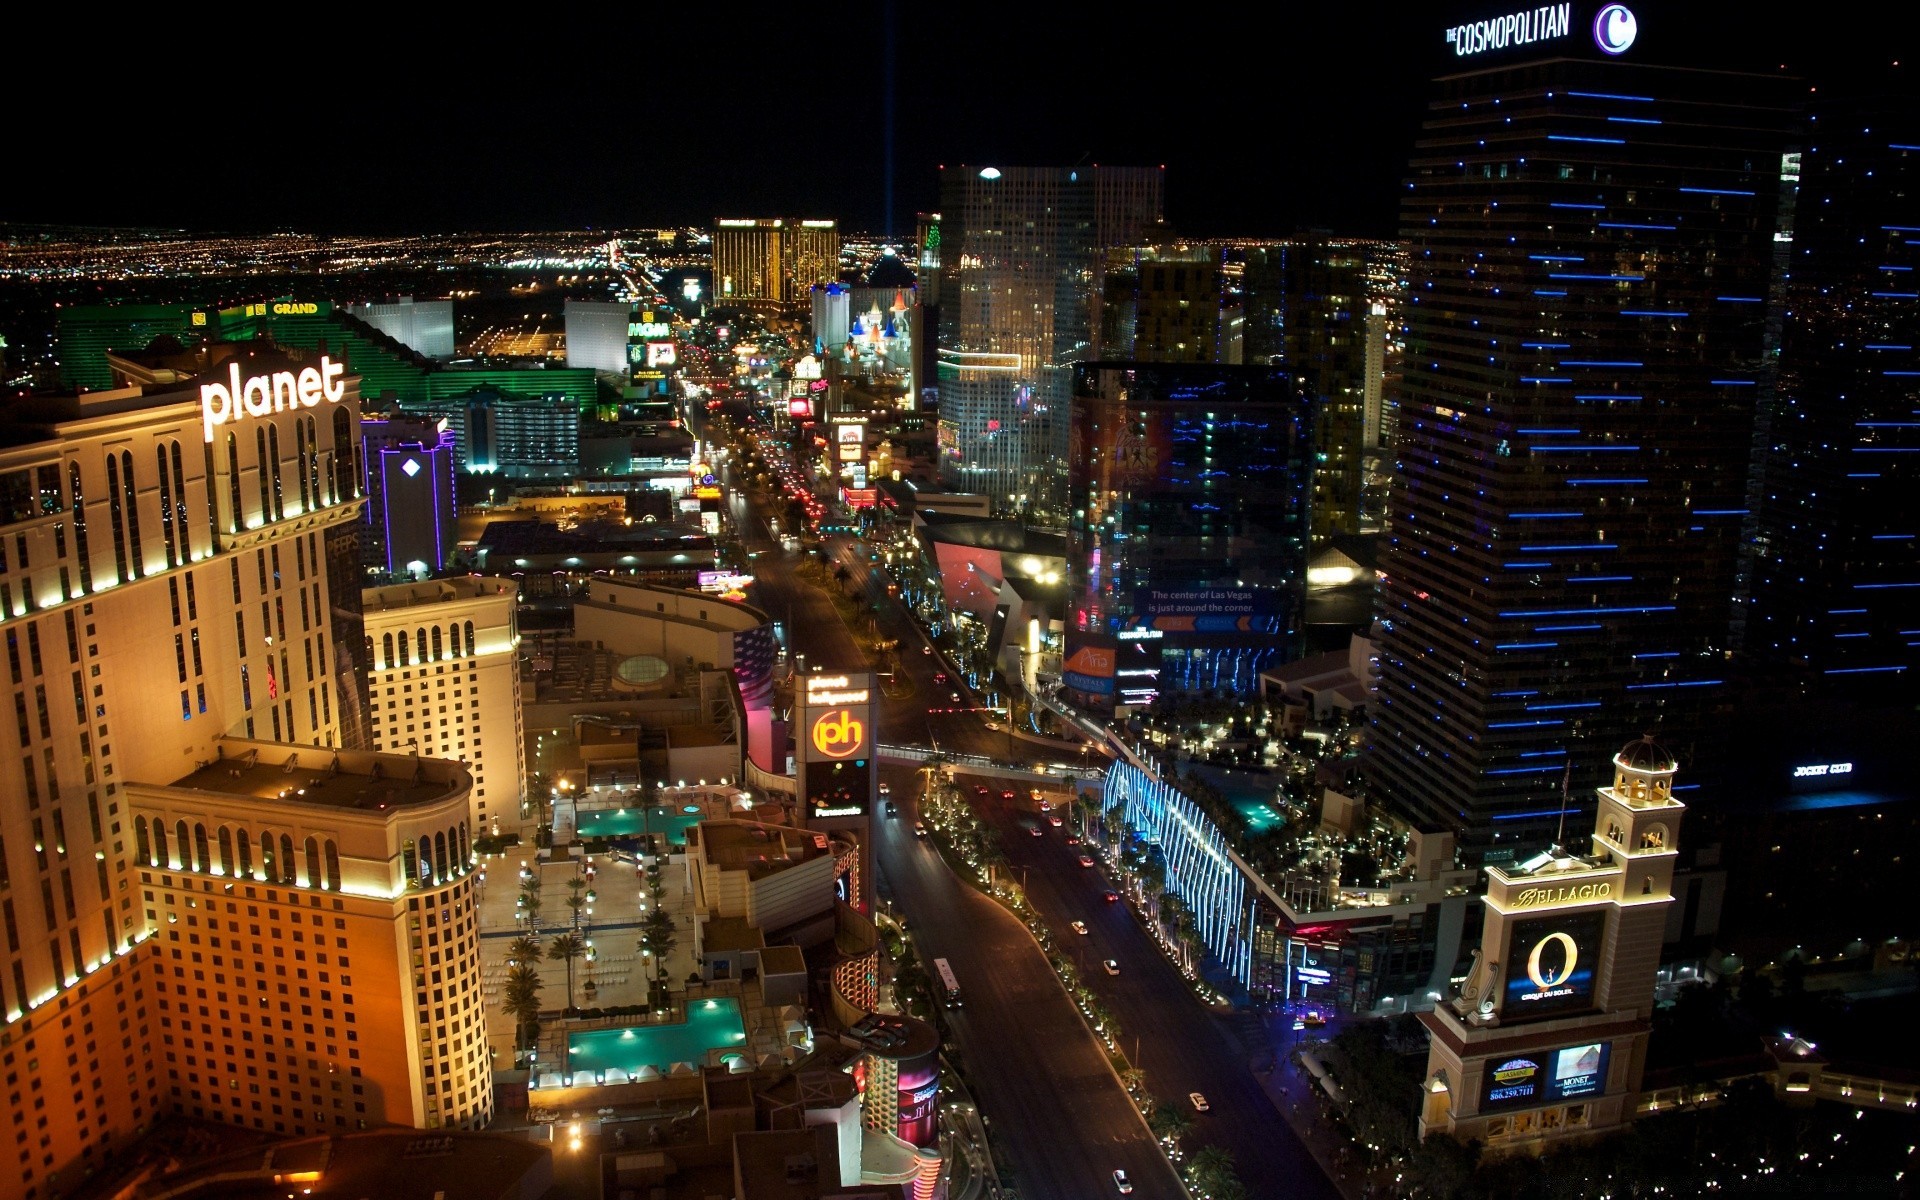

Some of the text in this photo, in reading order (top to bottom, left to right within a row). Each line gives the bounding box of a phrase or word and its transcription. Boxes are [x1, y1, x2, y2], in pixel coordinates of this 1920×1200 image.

[1446, 2, 1570, 56] THE COSMOPOLITAN
[273, 303, 317, 315] GRAND
[628, 323, 669, 337] MGM
[200, 356, 345, 443] planet
[1151, 590, 1253, 601] The center of Las Vegas
[1148, 603, 1254, 613] is just around the corner.
[1119, 630, 1163, 640] COSMOPOLITAN
[1080, 648, 1108, 668] Aria
[808, 675, 848, 692] planet
[808, 690, 869, 706] hollywood
[817, 710, 862, 754] ph
[1794, 762, 1852, 777] JOCKEY CLUB
[815, 806, 862, 818] Panasonic
[1511, 882, 1611, 908] BELLAGIO
[1527, 931, 1578, 988] O
[1521, 988, 1574, 1001] CIRQUE DU SOLEIL
[1502, 1069, 1528, 1079] JASMINE
[1563, 1075, 1590, 1087] MONET
[1489, 1088, 1534, 1101] 866.259.7111
